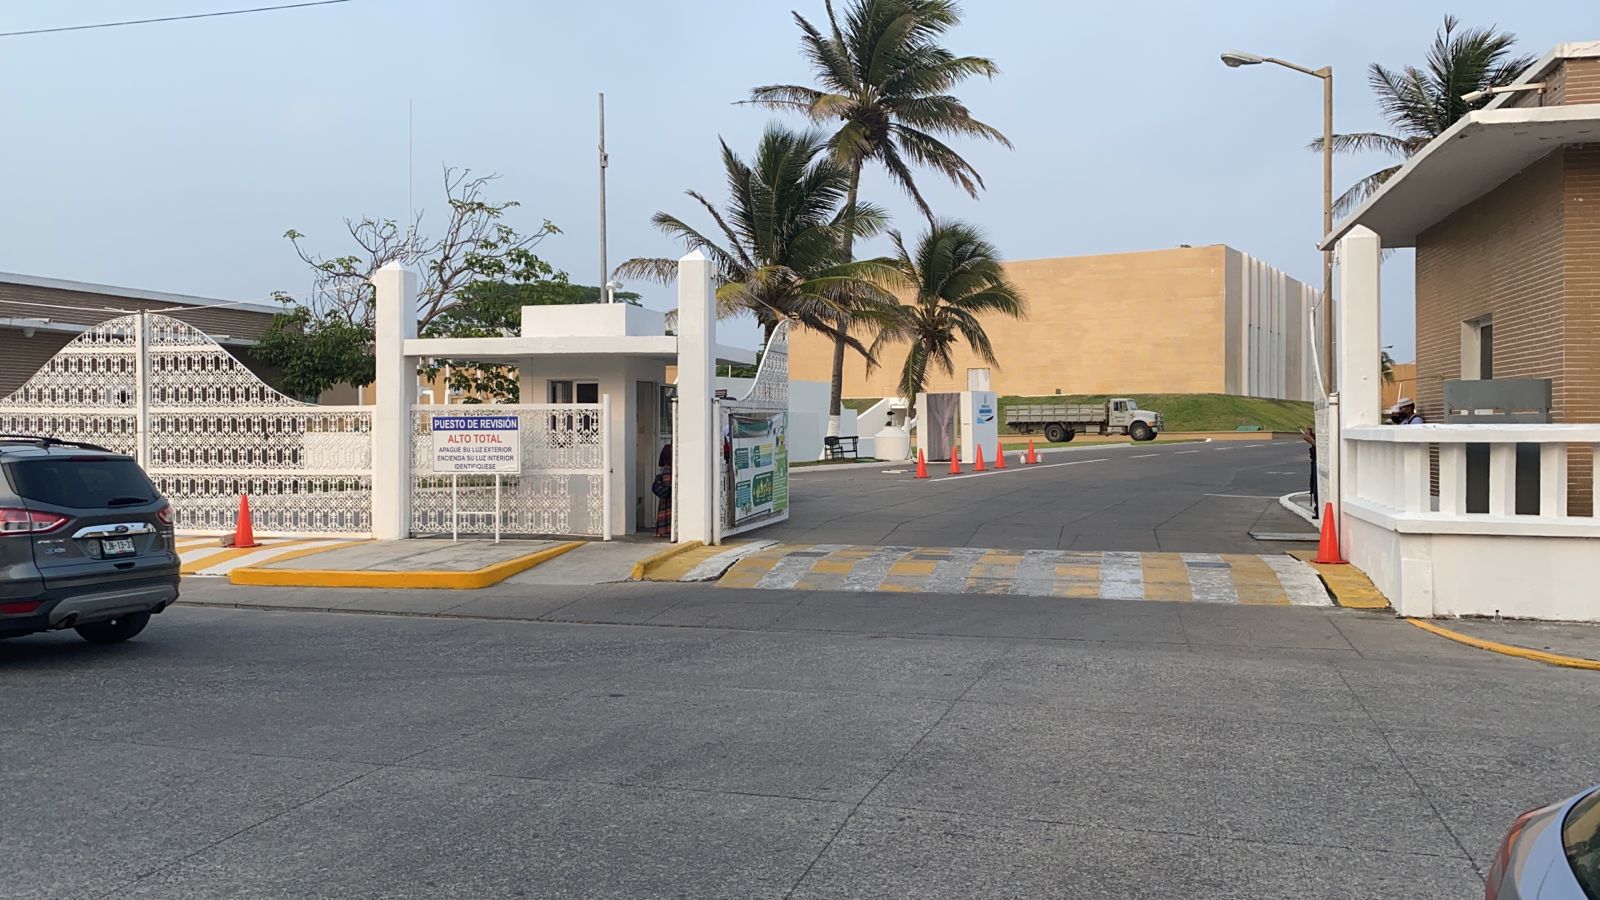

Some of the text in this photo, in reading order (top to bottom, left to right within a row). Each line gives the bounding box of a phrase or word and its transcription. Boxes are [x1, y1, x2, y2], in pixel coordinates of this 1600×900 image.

[434, 417, 517, 429] PUESTO DE REVISIÓN
[447, 434, 502, 444] ALTO TOTAL
